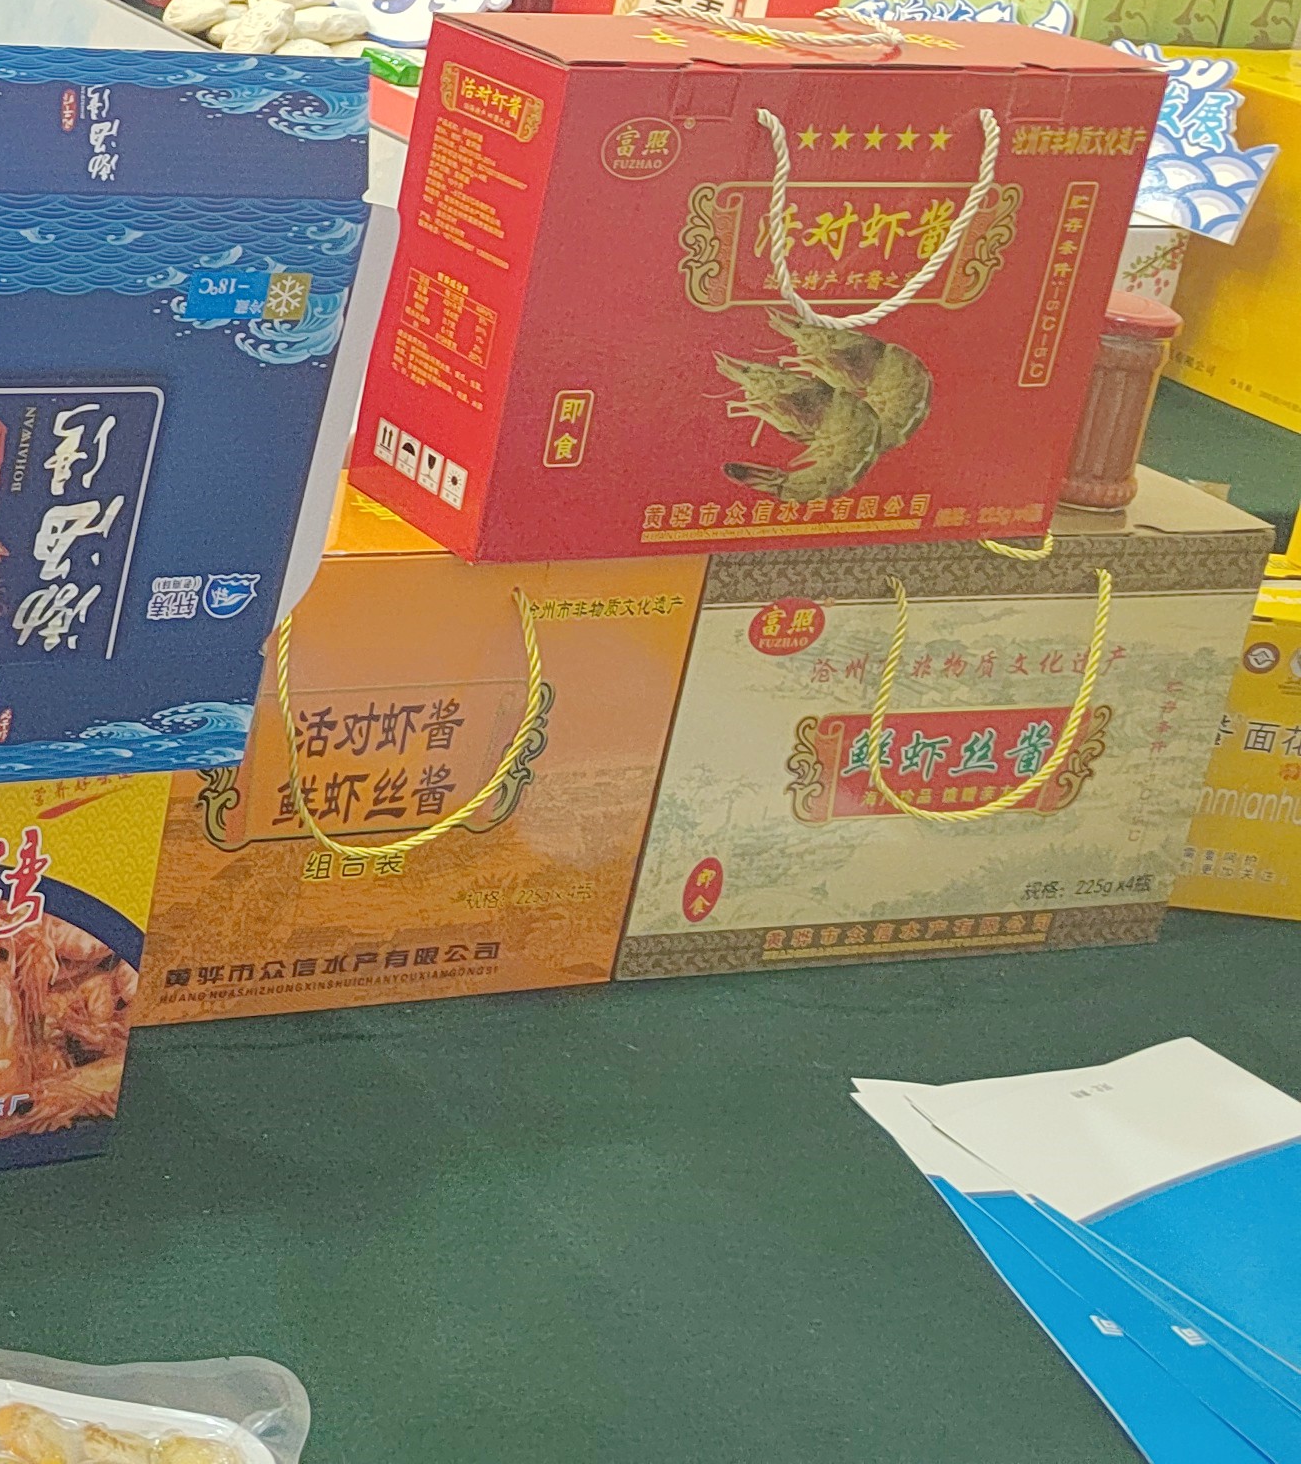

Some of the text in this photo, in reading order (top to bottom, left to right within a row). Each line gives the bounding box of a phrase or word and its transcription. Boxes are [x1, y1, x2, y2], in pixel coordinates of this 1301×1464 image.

[614, 125, 670, 157] 富照
[612, 158, 664, 172] FUZHAO
[754, 199, 955, 261] 活对虾酱
[11, 406, 38, 494] BOHAIWAN
[553, 398, 585, 463] 即食
[11, 402, 126, 653] 渤海湾
[643, 493, 933, 530] 黄骅市众信水产有限公司
[147, 592, 198, 620] 轩涛
[529, 594, 685, 621] 沧州市非物质文化遗产
[760, 605, 817, 637] 富照
[758, 635, 810, 650] FUZHAO
[294, 697, 466, 758] 活对虾酱
[842, 721, 1055, 787] 鲜虾丝酱
[272, 763, 458, 829] 鲜虾丝酱
[303, 851, 406, 881] 组合装
[164, 941, 502, 989] 黄骅市众信水产有限公司
